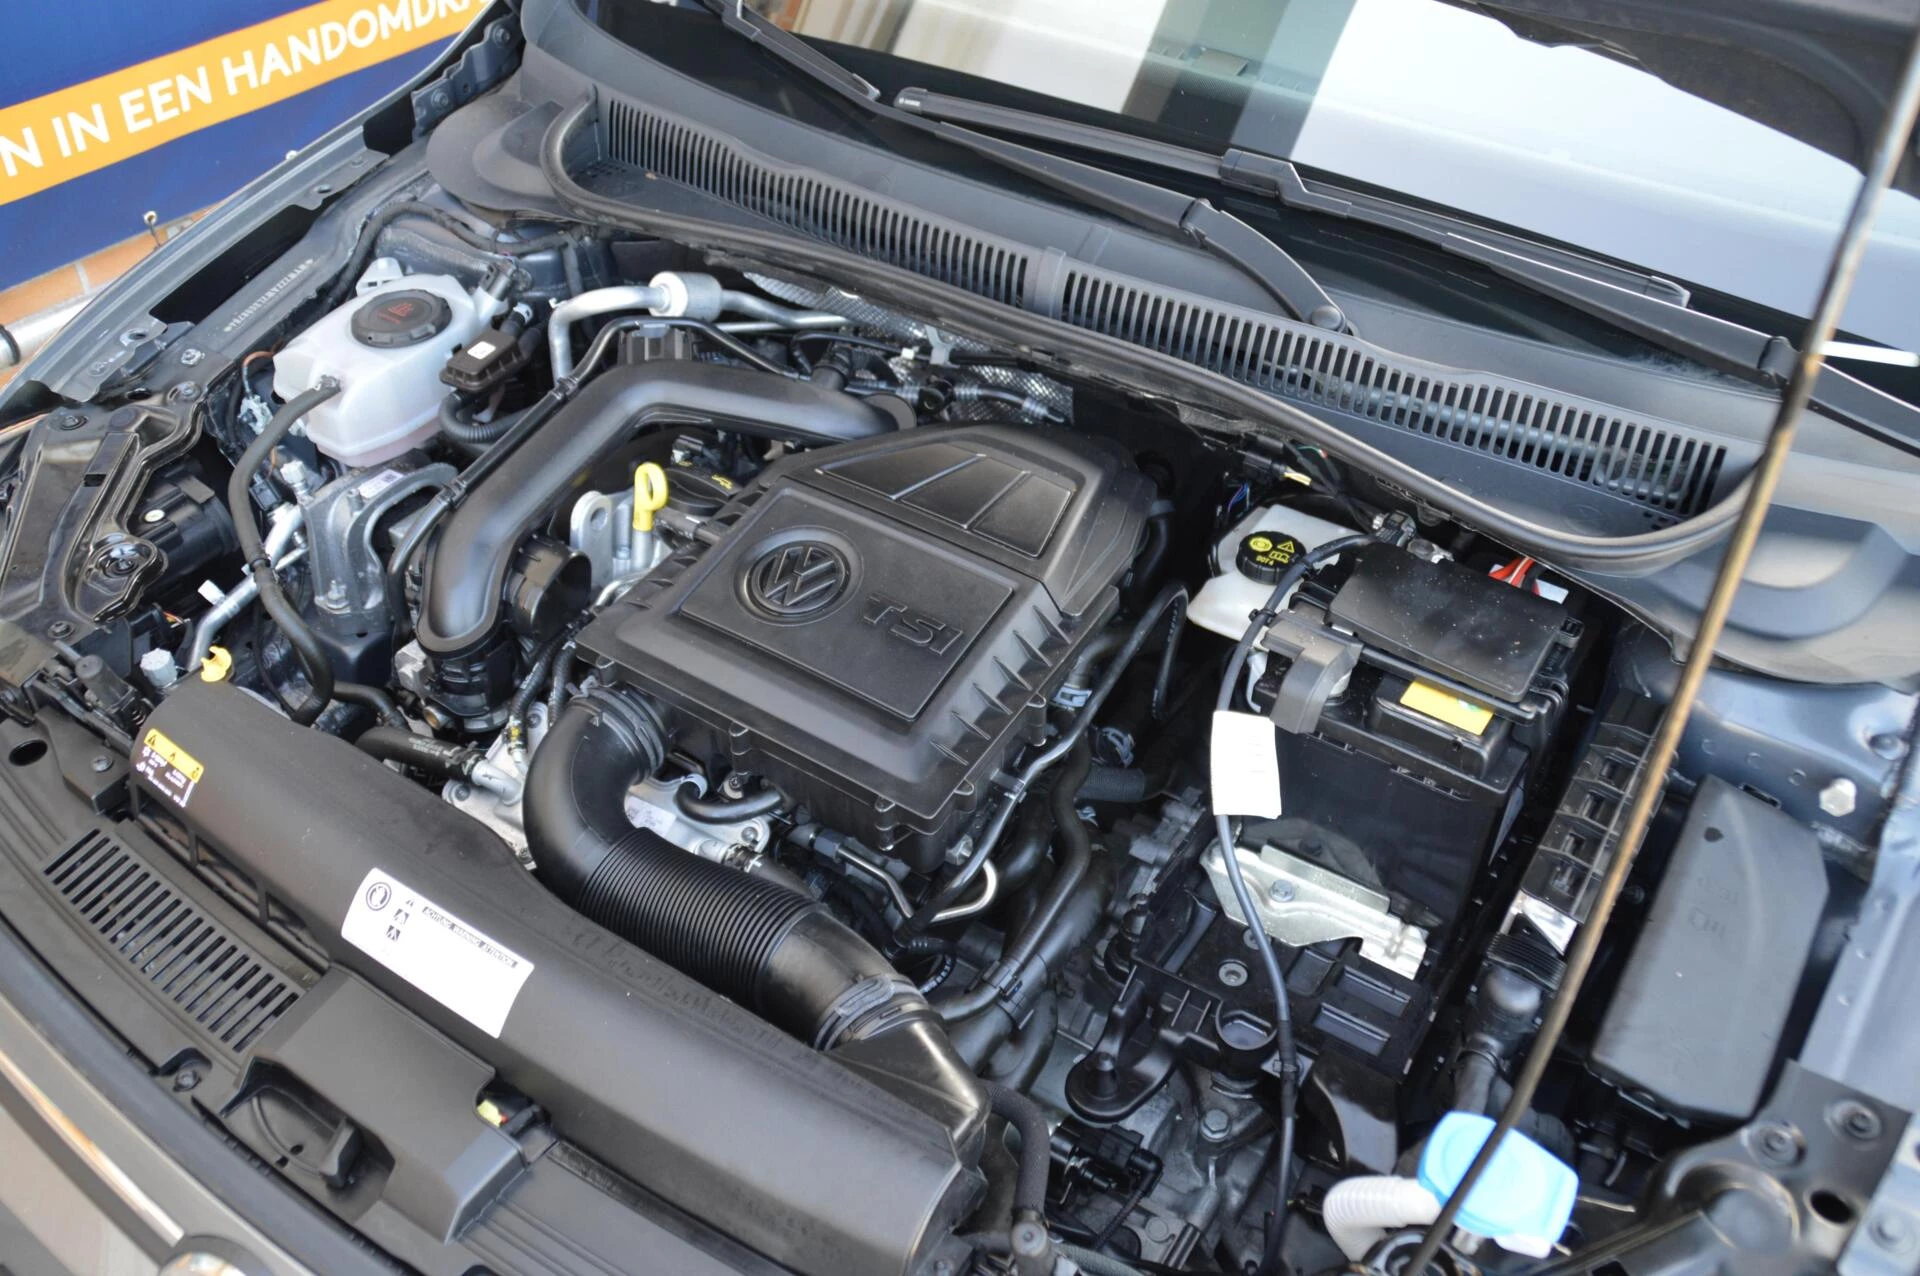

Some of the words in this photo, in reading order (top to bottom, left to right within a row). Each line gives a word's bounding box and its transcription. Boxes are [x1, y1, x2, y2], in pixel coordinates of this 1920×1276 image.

[51, 103, 110, 158] IN
[119, 66, 212, 133] EEN
[221, 0, 486, 96] HANDOMD
[863, 592, 964, 656] TSI
